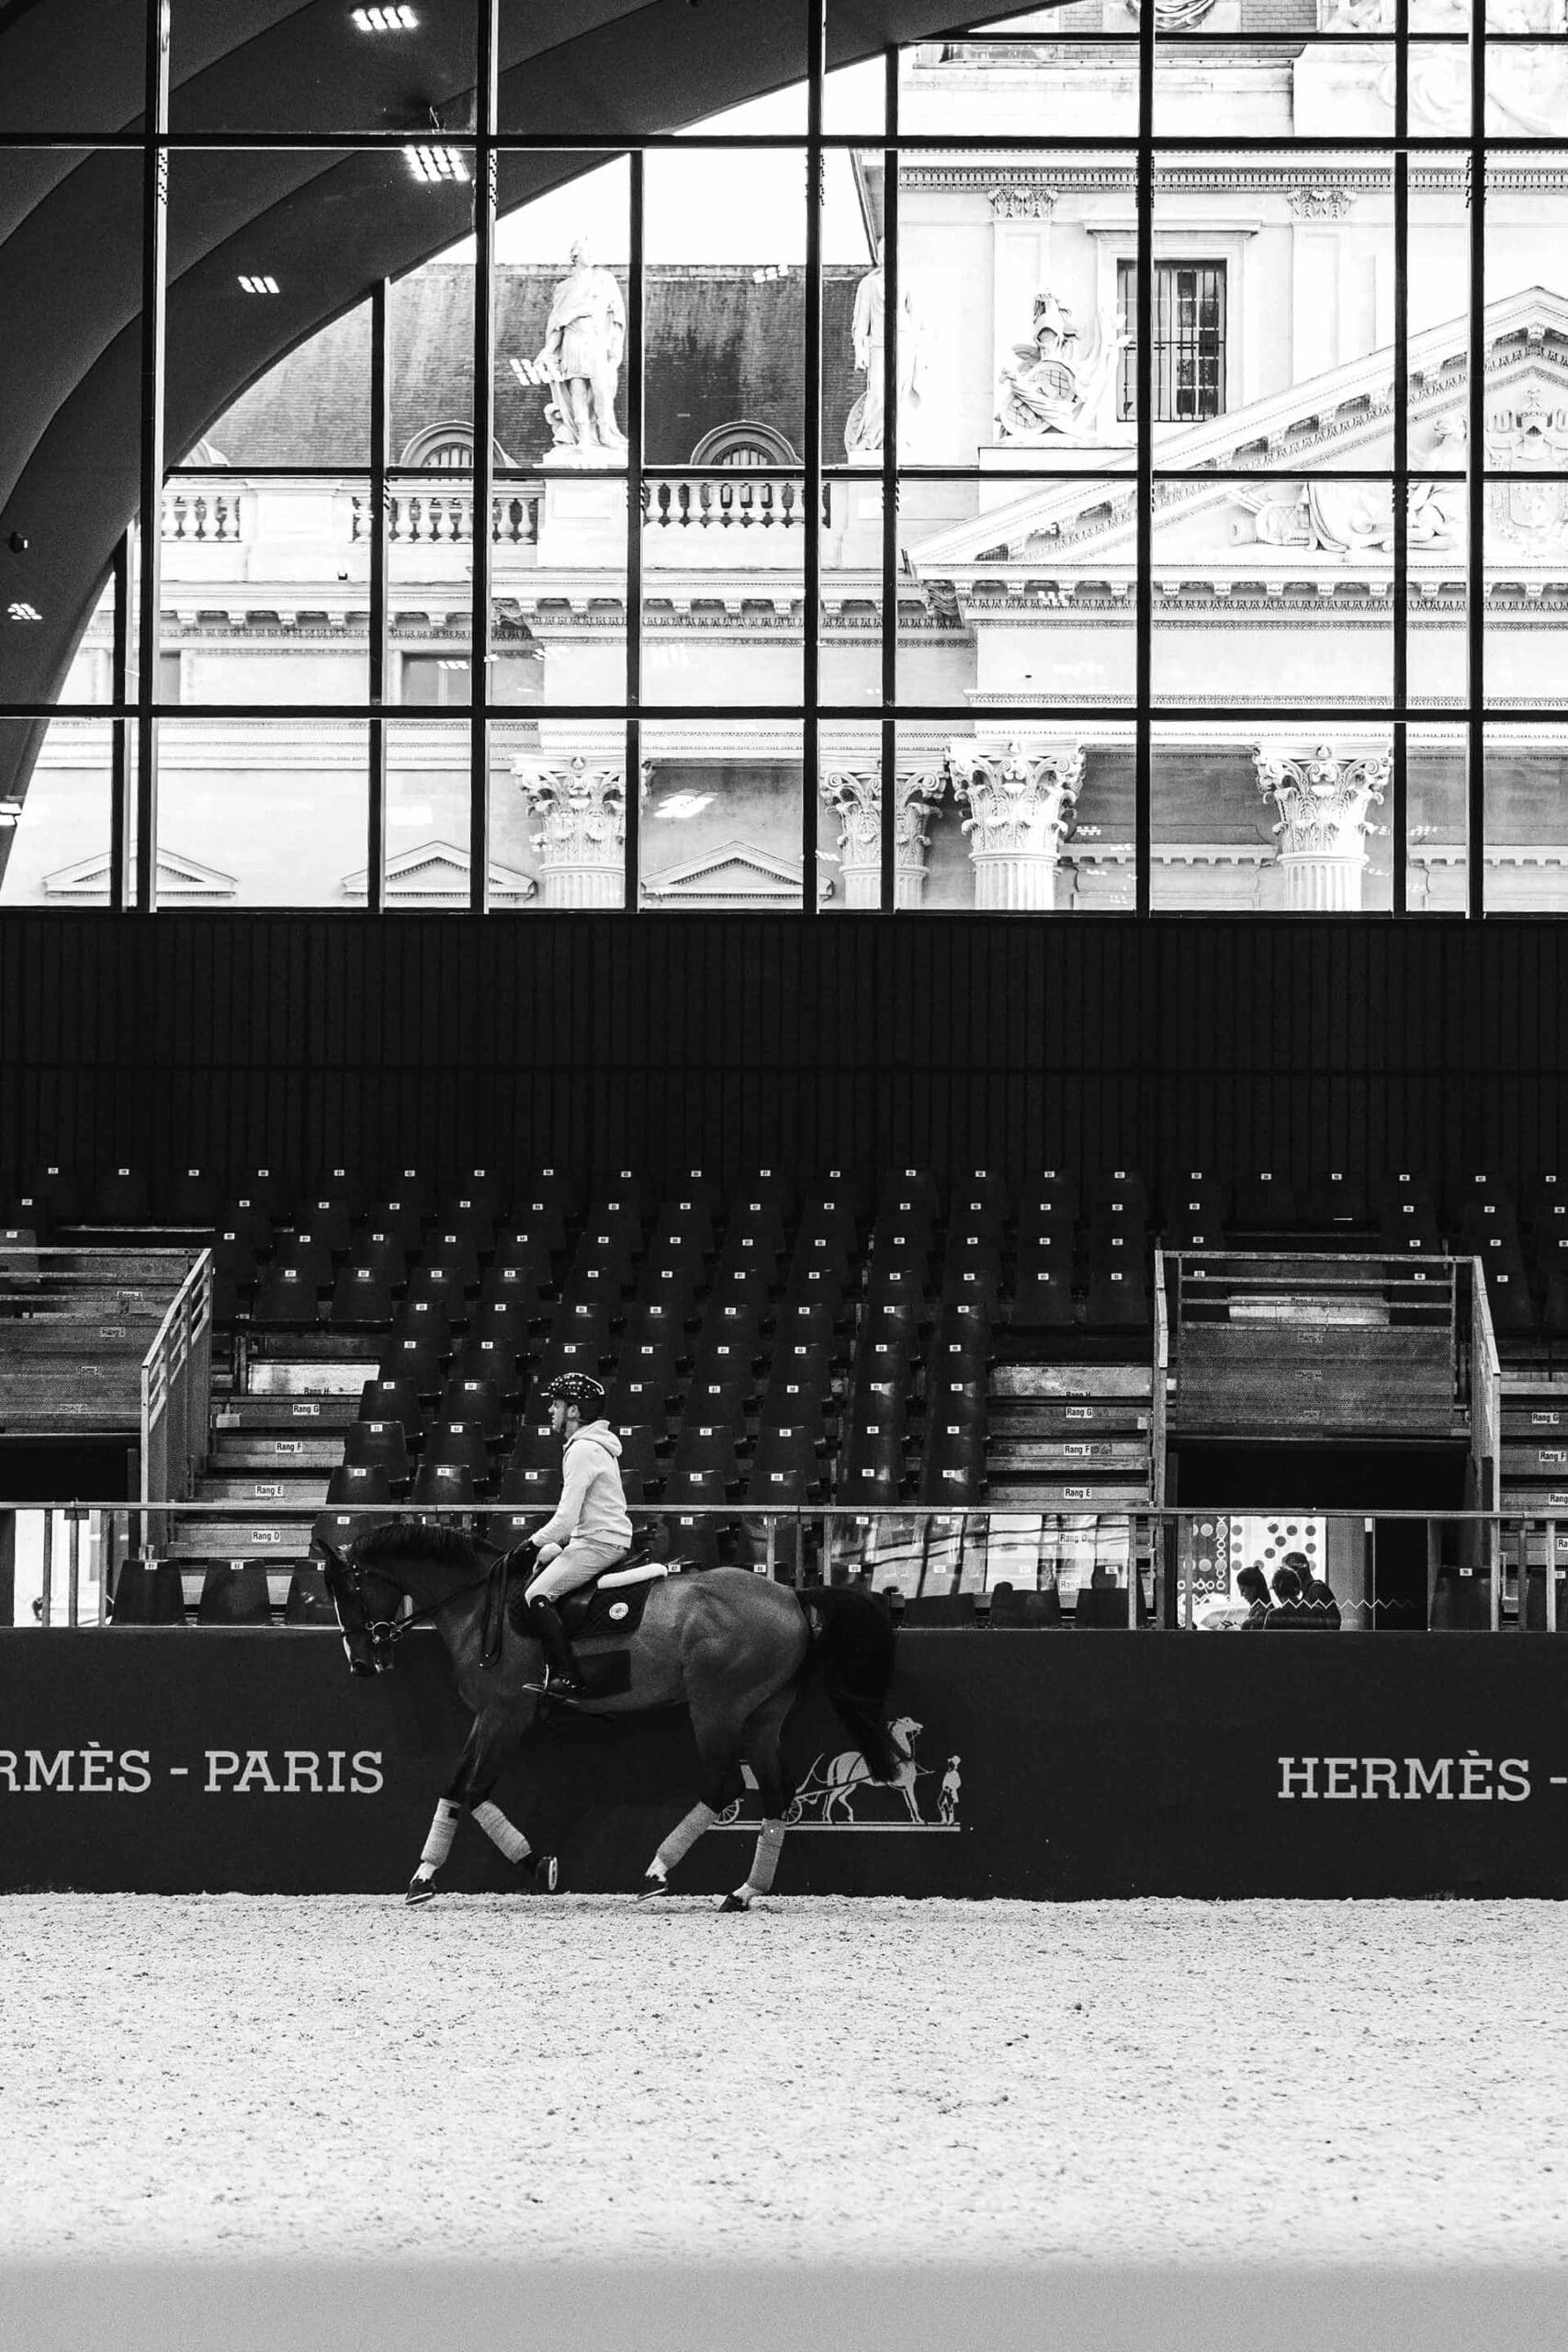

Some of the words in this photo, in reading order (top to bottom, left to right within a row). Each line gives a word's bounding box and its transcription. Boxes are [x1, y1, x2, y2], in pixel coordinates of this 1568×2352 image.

[293, 1405, 311, 1414] Rang
[314, 1405, 319, 1413] G
[1066, 1408, 1085, 1417] Rang
[1532, 1414, 1551, 1422] Rang
[276, 1442, 295, 1452] Rang
[297, 1442, 302, 1451] F
[1065, 1445, 1083, 1454] Rang
[1085, 1445, 1090, 1453] F
[1540, 1452, 1559, 1462] Rang
[1561, 1452, 1566, 1460] F
[256, 1486, 275, 1496] Rang
[277, 1486, 282, 1495] E
[1065, 1488, 1083, 1498] Rang
[1086, 1488, 1091, 1497] E
[1550, 1495, 1568, 1504] Rang
[253, 1532, 272, 1542] Rang
[274, 1532, 280, 1540] D
[1060, 1533, 1079, 1544] Rang
[204, 1749, 384, 1794] PARIS
[1278, 1749, 1531, 1802] HERMÈS
